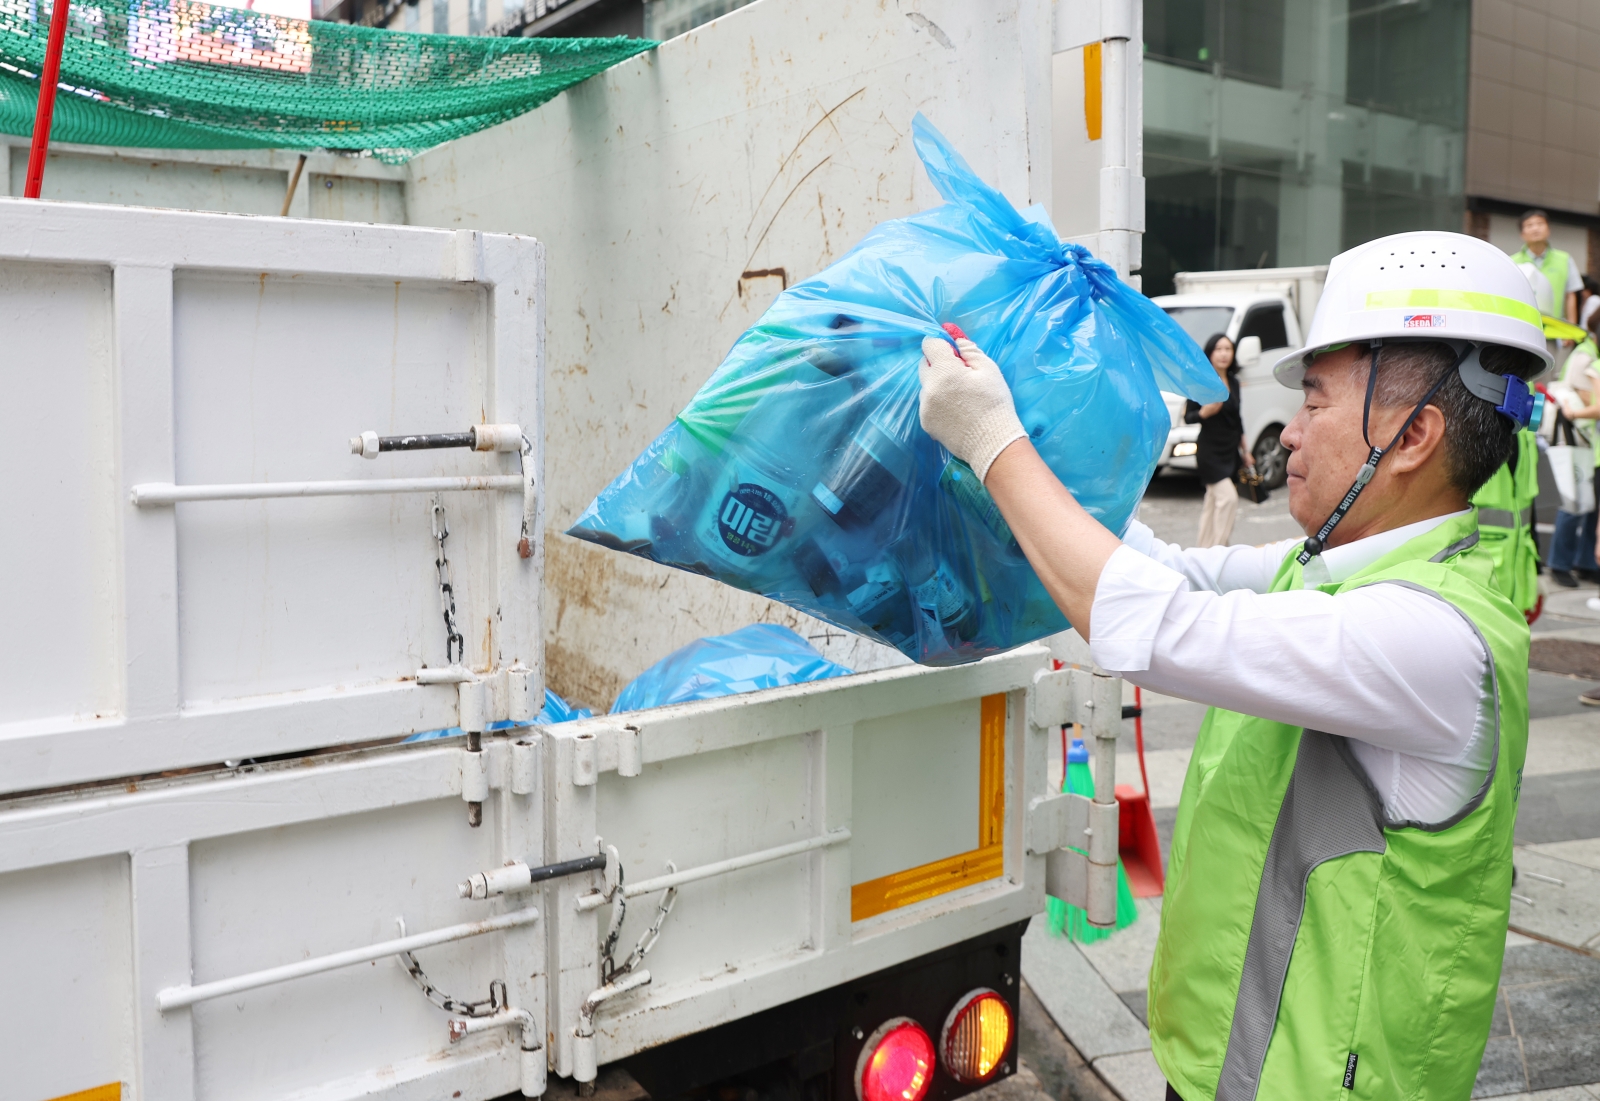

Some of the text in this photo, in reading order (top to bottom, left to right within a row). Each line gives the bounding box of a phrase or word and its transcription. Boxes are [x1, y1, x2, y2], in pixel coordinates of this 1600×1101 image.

[1404, 320, 1430, 328] SSEDA
[1339, 492, 1357, 511] SAFETY
[721, 496, 782, 547] 미림
[1317, 512, 1342, 541] AFETY FIRST
